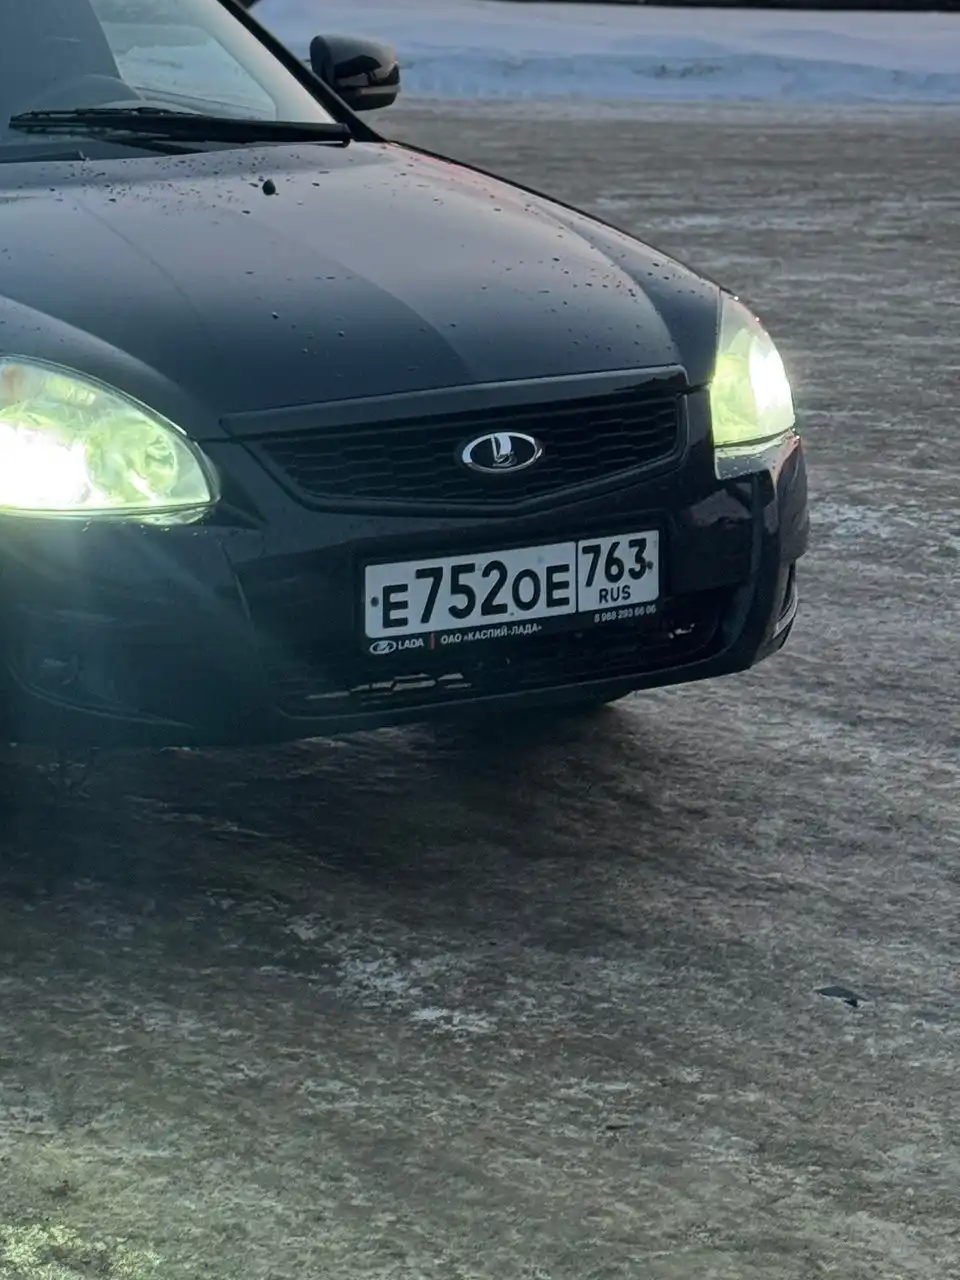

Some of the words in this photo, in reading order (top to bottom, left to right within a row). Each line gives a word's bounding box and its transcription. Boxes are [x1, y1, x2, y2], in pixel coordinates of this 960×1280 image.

[382, 560, 570, 629] Е752ОЕ
[582, 538, 648, 587] 763
[599, 585, 631, 604] RUS
[398, 638, 424, 650] LADA
[441, 634, 462, 644] ОАО
